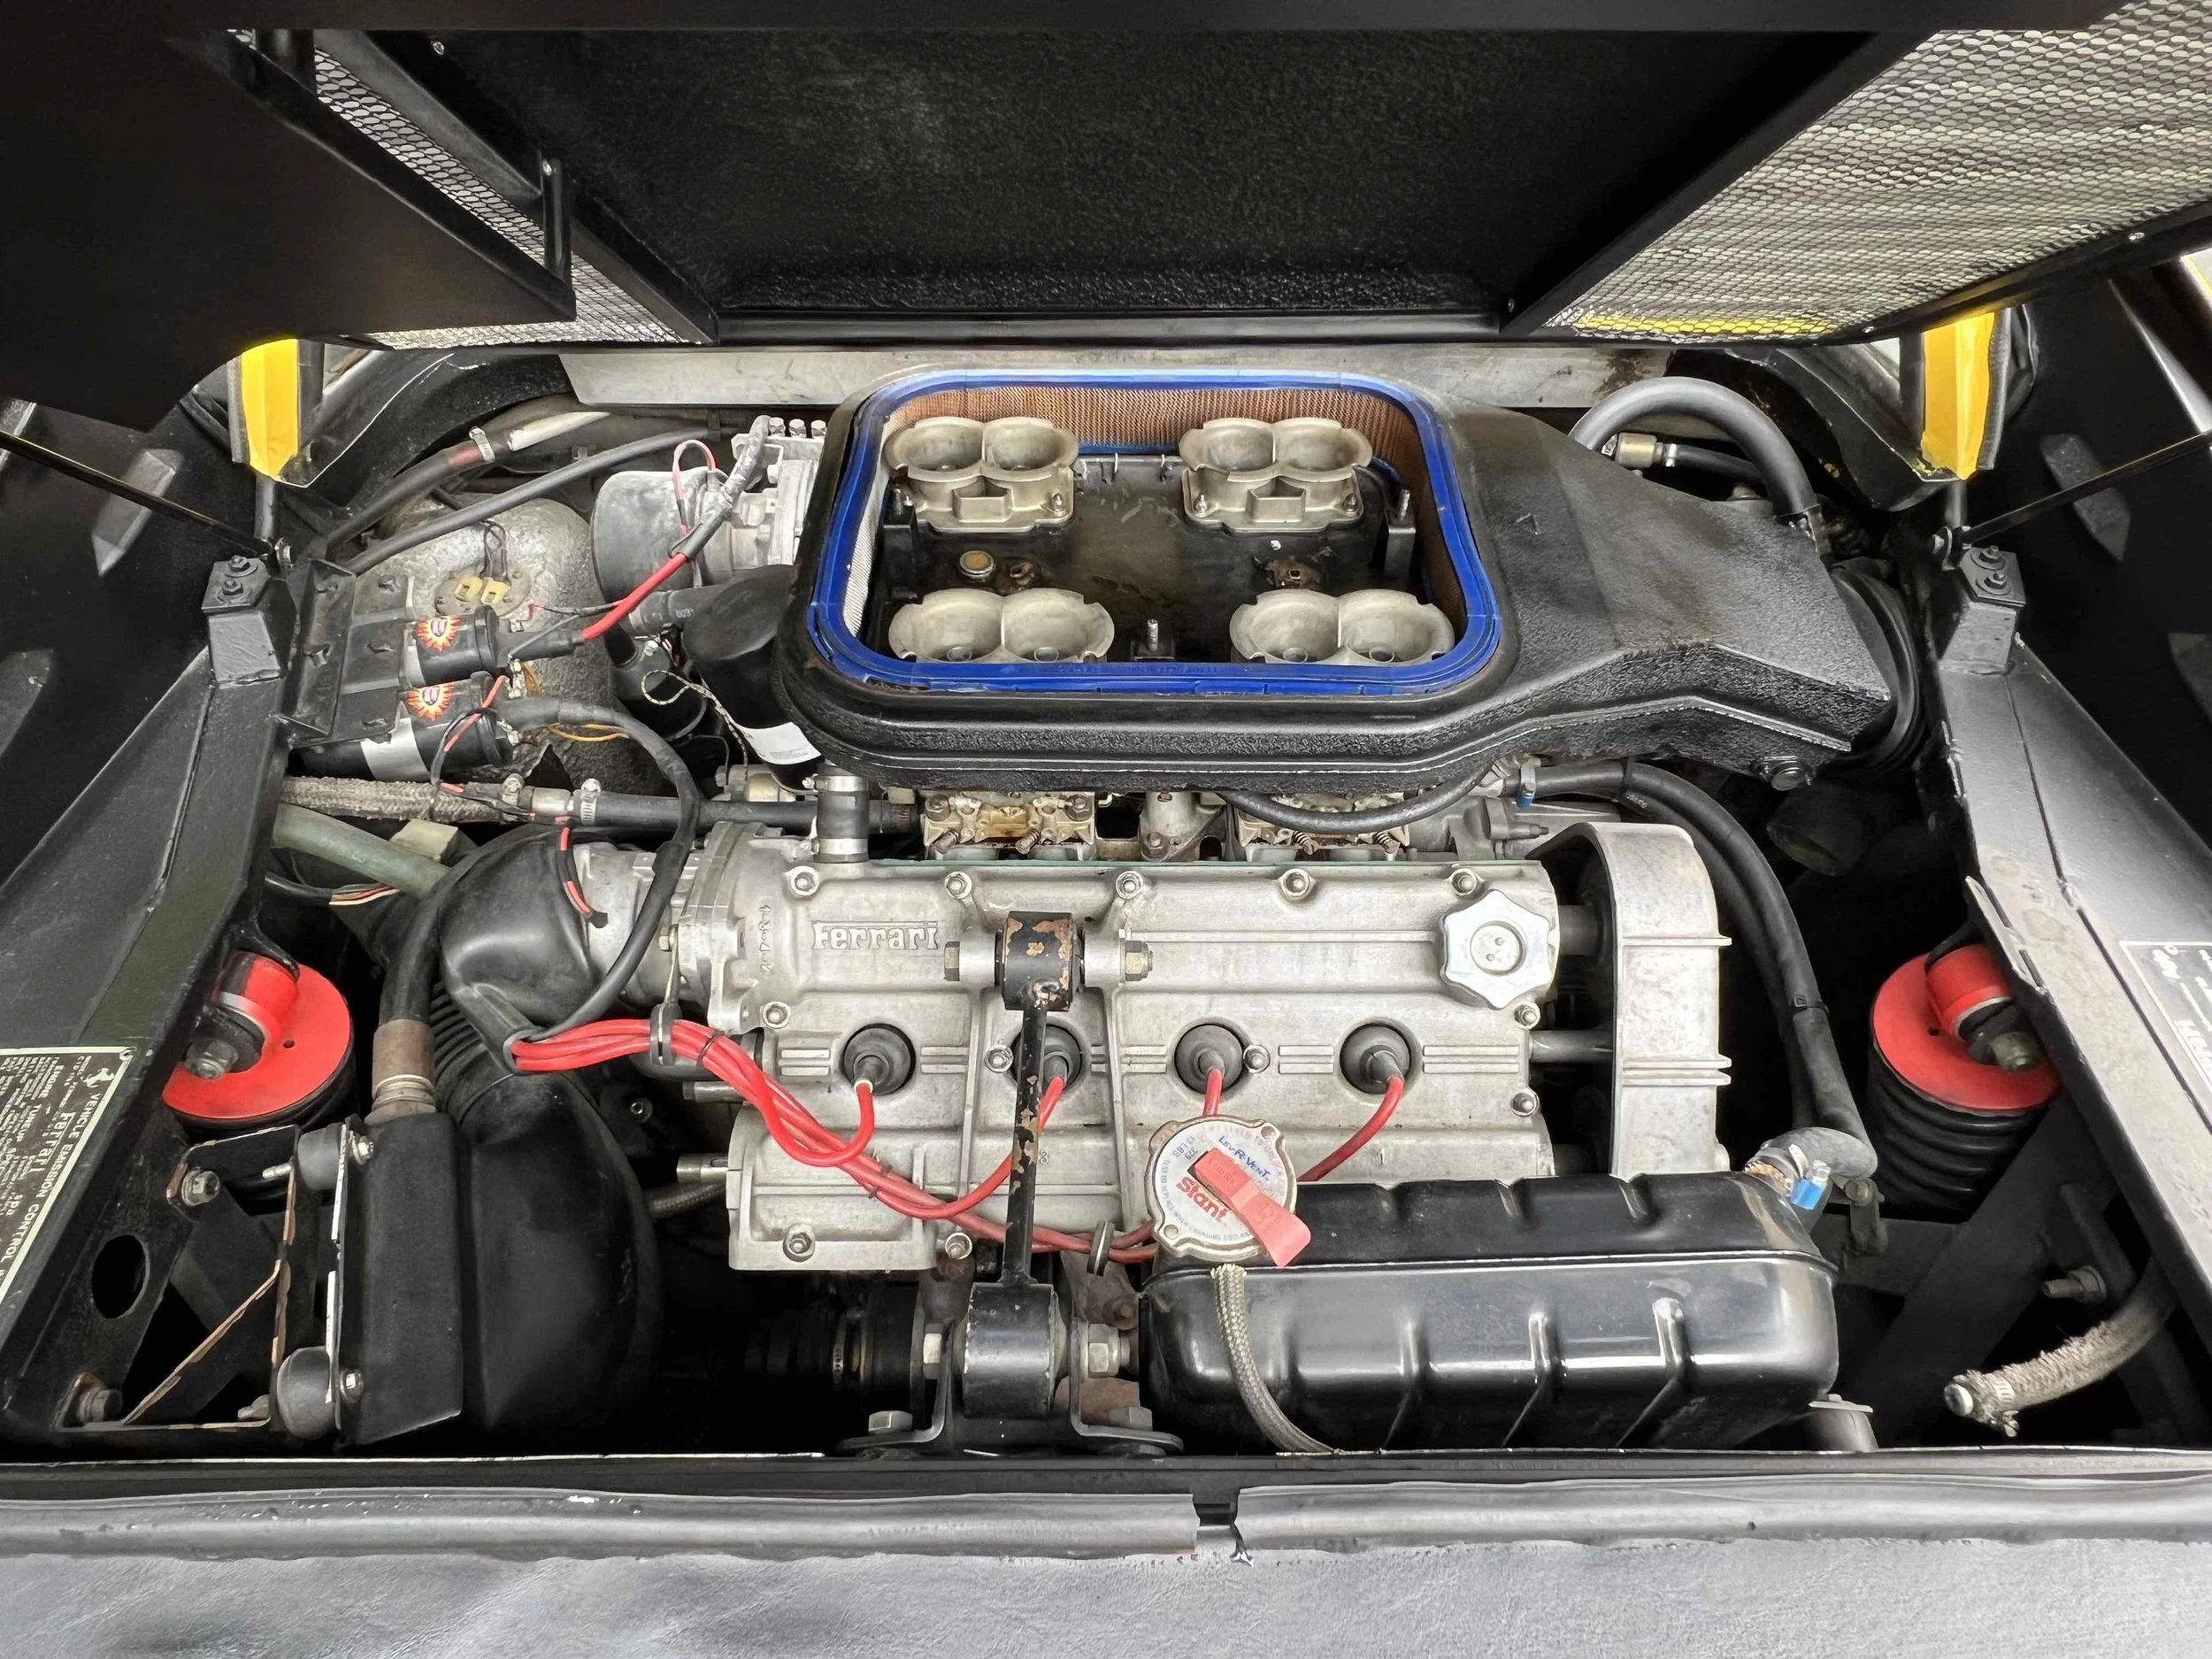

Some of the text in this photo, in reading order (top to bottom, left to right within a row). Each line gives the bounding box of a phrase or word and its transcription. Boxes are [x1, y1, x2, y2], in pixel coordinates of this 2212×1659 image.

[811, 920, 939, 950] Ferrari
[69, 1093, 101, 1139] VEHICLE
[29, 1112, 76, 1173] Ferrari
[36, 1144, 74, 1198] EMISSION
[1176, 1176, 1230, 1223] Stant
[1, 1203, 40, 1263] CONTROL
